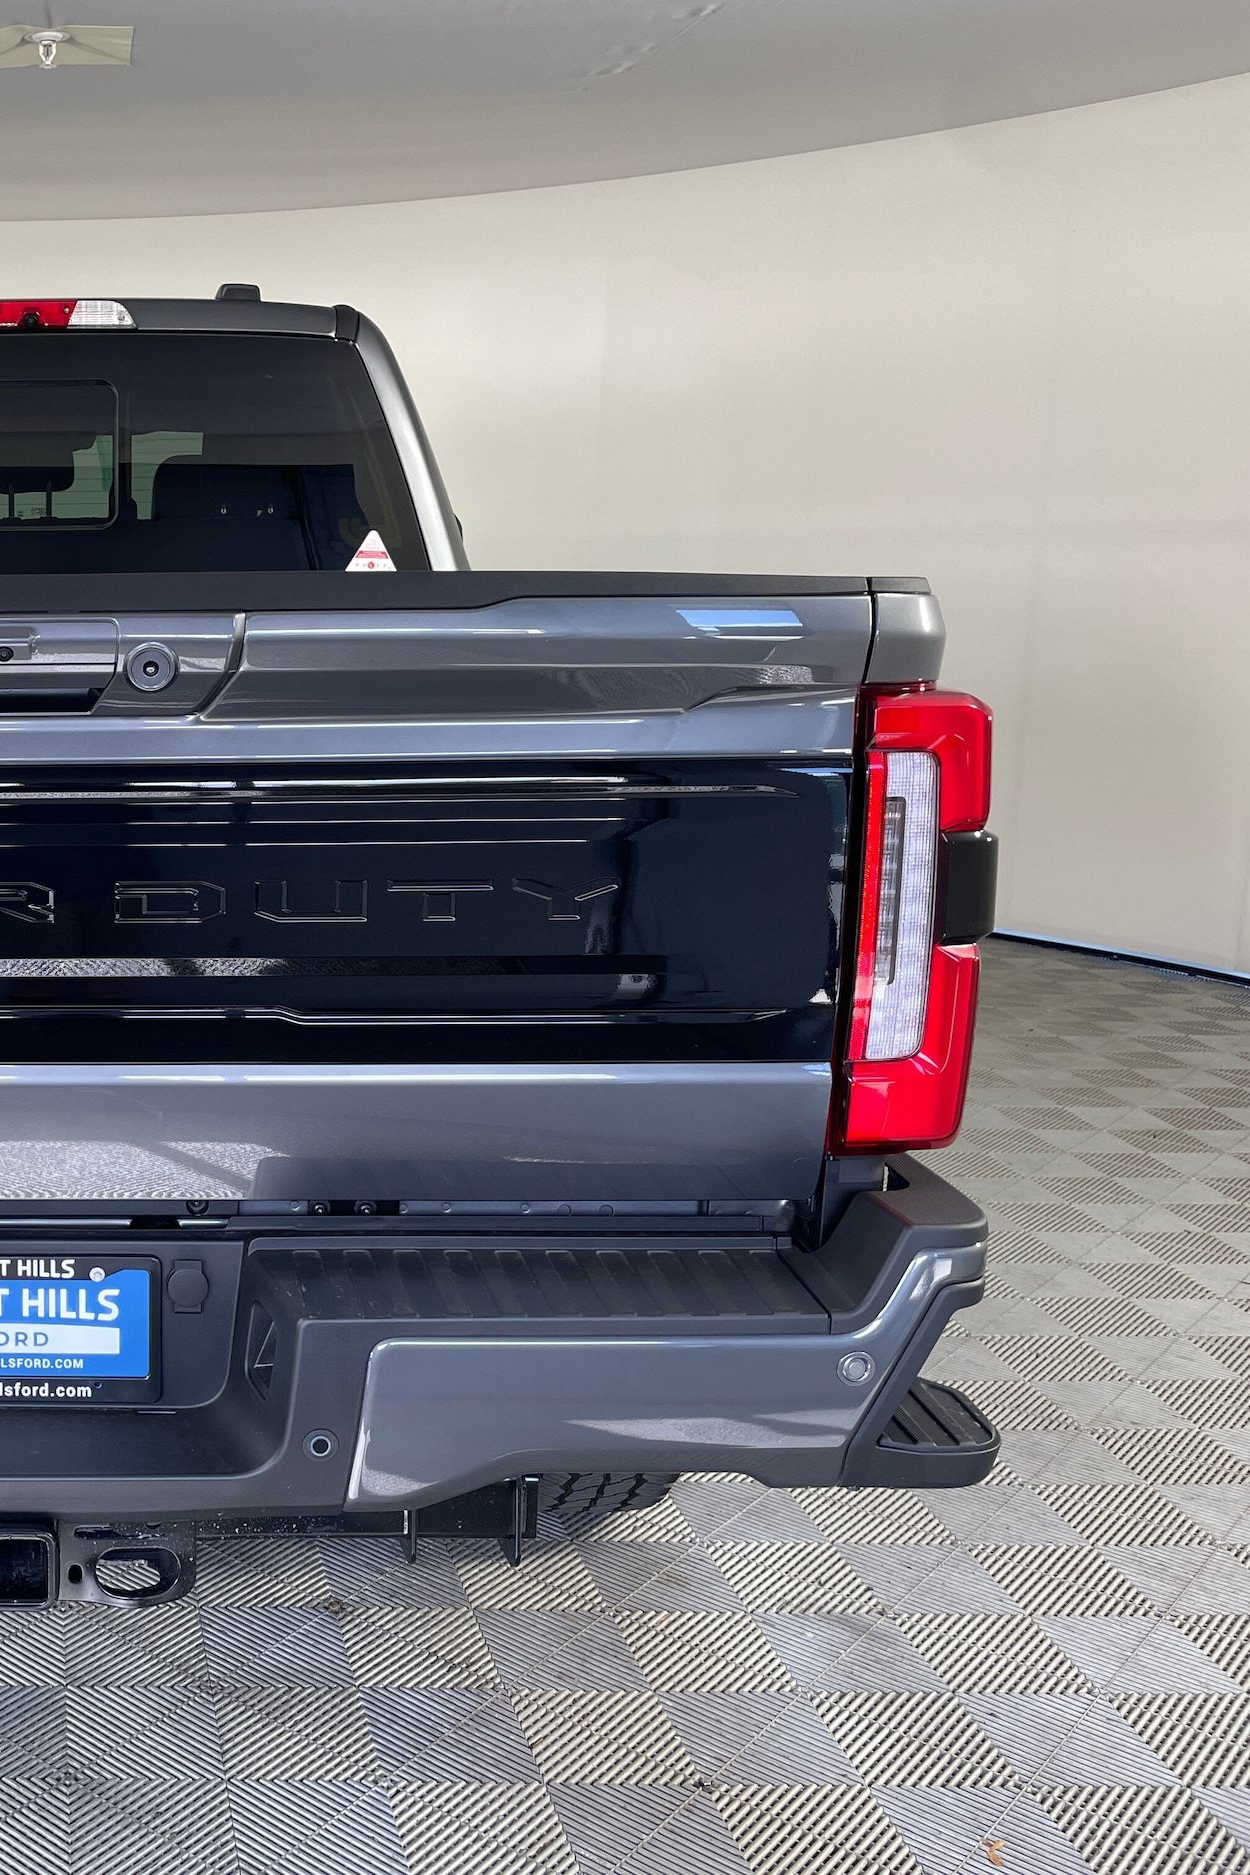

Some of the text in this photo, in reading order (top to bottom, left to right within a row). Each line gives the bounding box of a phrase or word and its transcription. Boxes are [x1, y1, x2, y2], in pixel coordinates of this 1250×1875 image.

[113, 877, 620, 924] DUTY
[17, 1259, 75, 1278] HILLS
[21, 1288, 120, 1321] HILLS
